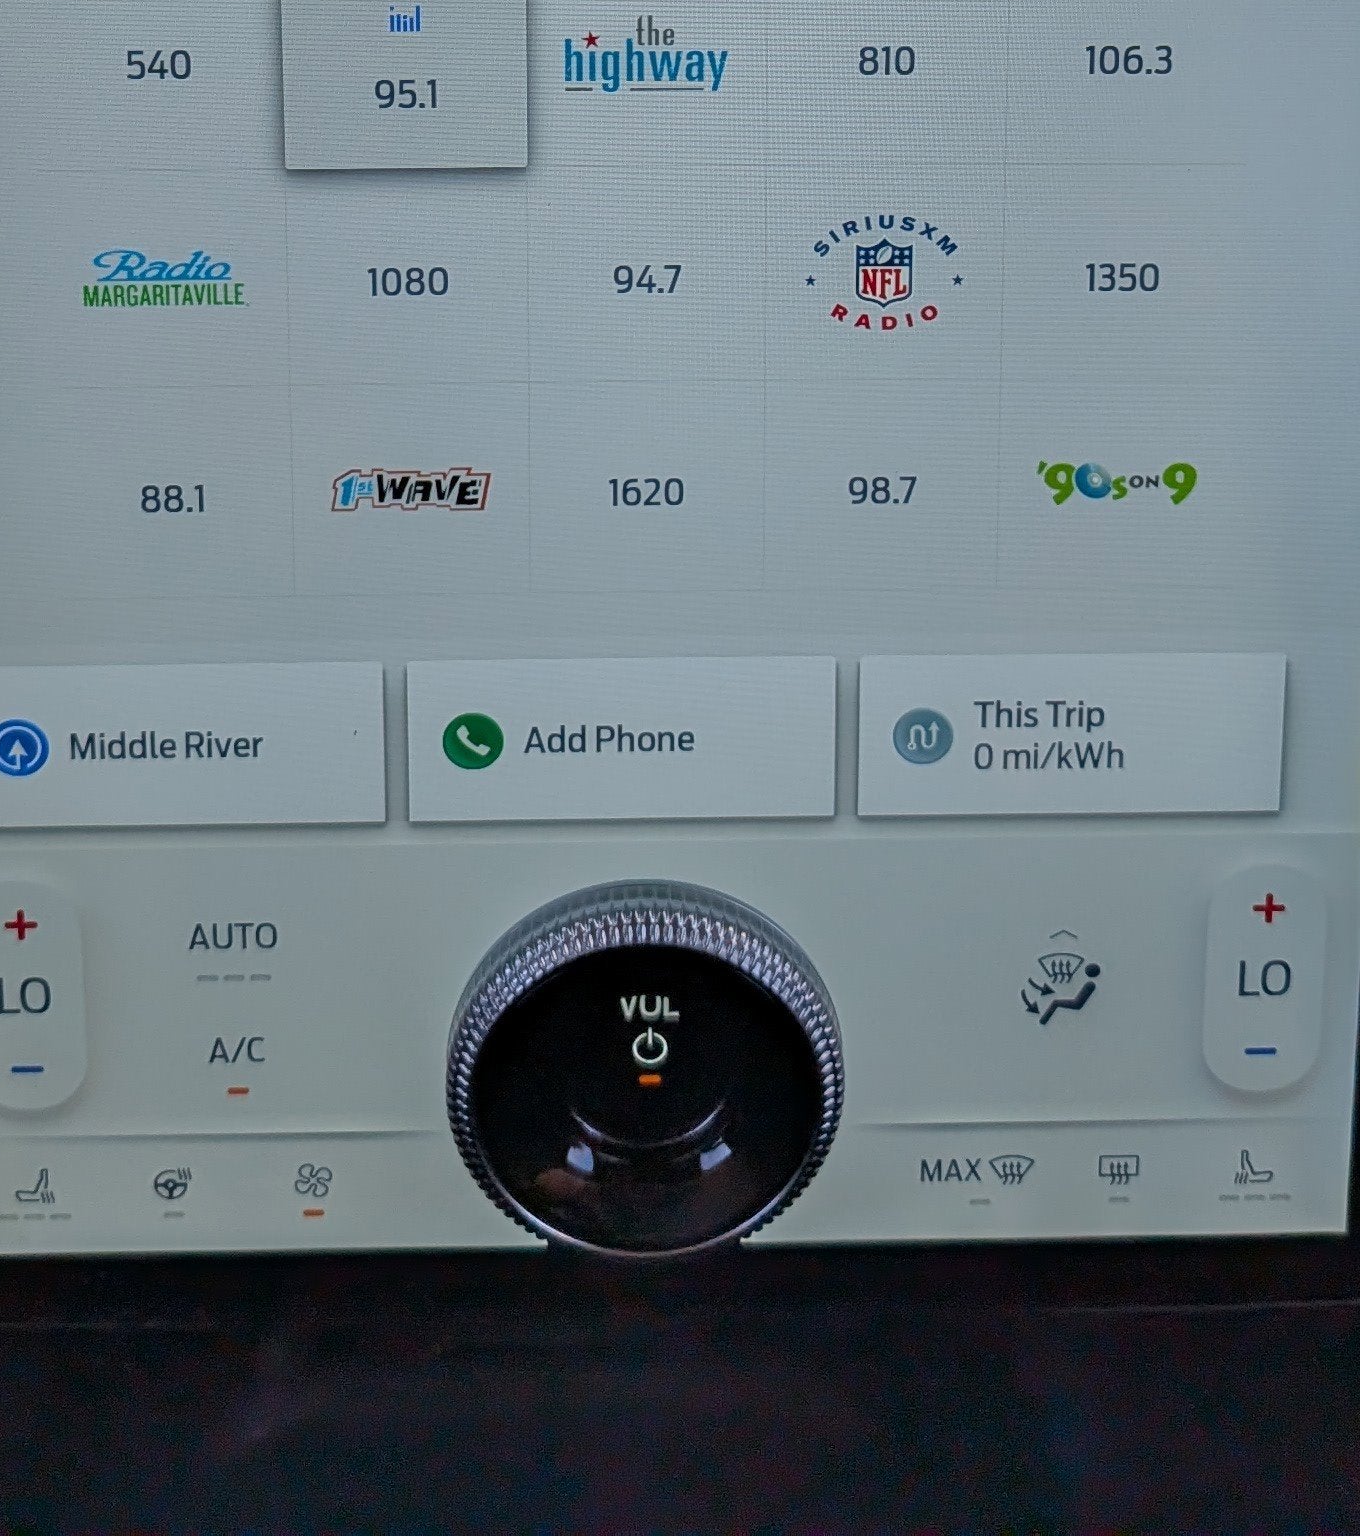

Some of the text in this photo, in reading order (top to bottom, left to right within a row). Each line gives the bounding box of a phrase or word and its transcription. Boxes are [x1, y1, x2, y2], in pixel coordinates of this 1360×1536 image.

[636, 14, 675, 46] the
[126, 50, 192, 79] 540
[564, 38, 728, 92] highway
[858, 46, 916, 76] 810
[1085, 45, 1173, 76] 106.3
[375, 80, 438, 109] 95.1
[813, 215, 958, 257] SIRIUSXM
[93, 250, 232, 281] Radio
[613, 265, 682, 294] 94.7
[1085, 264, 1160, 293] 1350
[82, 283, 245, 307] MARGARITAVILLE
[367, 267, 449, 296] 1080
[861, 268, 907, 300] NFL
[830, 303, 938, 330] RADIO
[341, 474, 482, 507] 1st WAVE
[608, 477, 684, 506] 1620
[848, 476, 917, 505] 98.7
[1162, 463, 1197, 505] 9
[141, 485, 206, 513] 88.1
[973, 700, 1106, 733] This Trip
[70, 731, 263, 760] Middle River
[524, 726, 695, 755] Add Phone
[973, 740, 1125, 772] 0 mi/kWh
[189, 923, 278, 950] AUTO
[1238, 960, 1291, 996] LO
[209, 1037, 266, 1064] A/C
[920, 1159, 982, 1182] MAX
